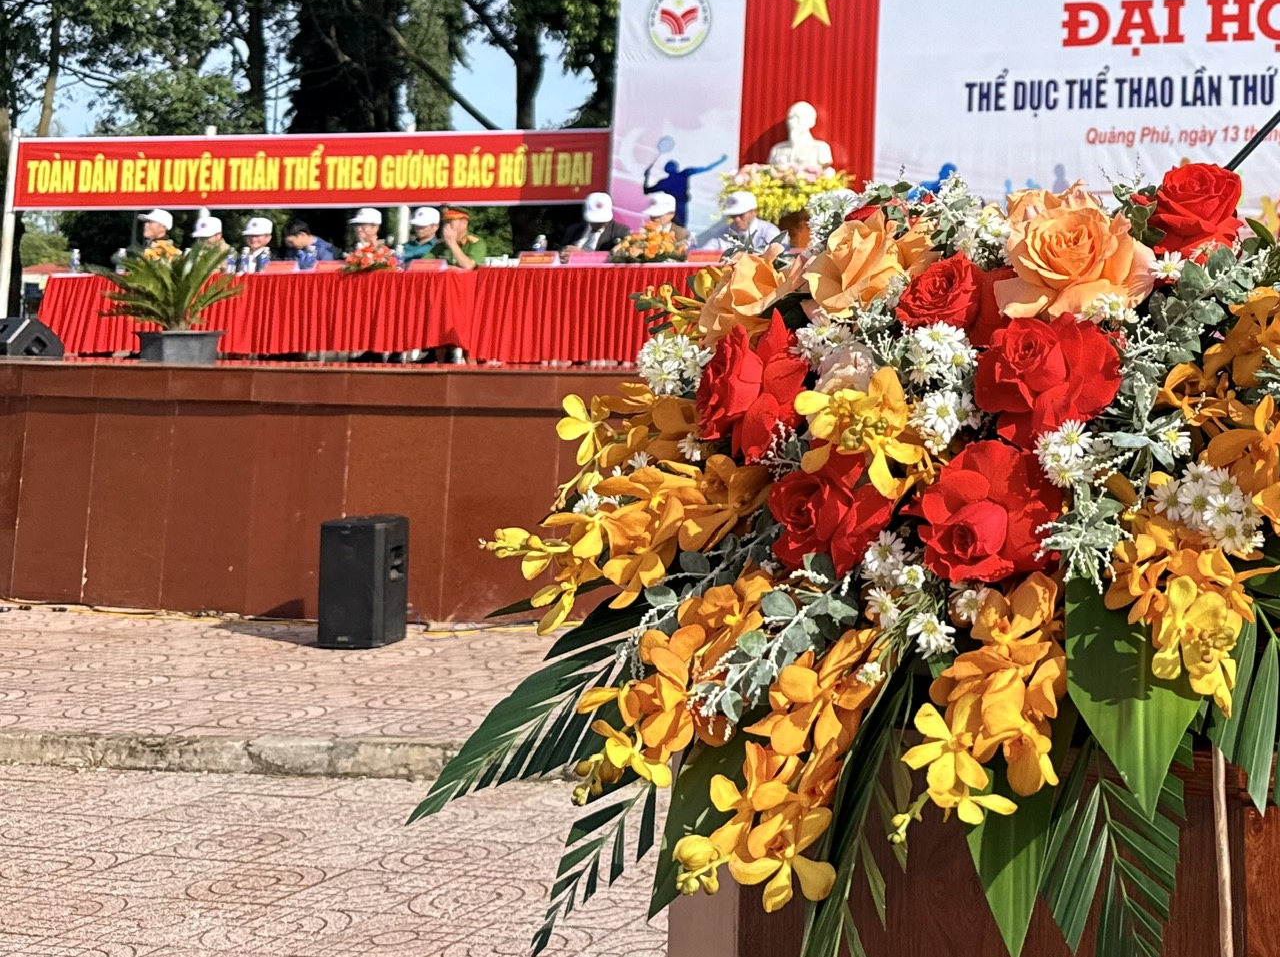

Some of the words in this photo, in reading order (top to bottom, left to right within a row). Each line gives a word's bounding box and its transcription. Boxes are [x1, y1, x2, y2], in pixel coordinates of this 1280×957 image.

[964, 68, 1009, 112] THỂ
[1013, 79, 1059, 118] DỤC
[1064, 65, 1110, 110] THỂ
[1114, 75, 1174, 108] THAO
[1180, 65, 1222, 107] LẦN
[1228, 66, 1279, 106] THỨ
[1086, 127, 1135, 148] Quảng
[1178, 124, 1216, 146] ngày
[1222, 125, 1239, 142] 13
[27, 153, 76, 194] TOÀN
[78, 153, 119, 193] DÂN
[120, 152, 160, 193] RÈN
[163, 151, 226, 198] LUYỆN
[228, 151, 280, 191] THÂN
[283, 144, 325, 190] THỂ
[325, 155, 377, 190] THEO
[380, 149, 450, 190] GƯƠNG
[452, 146, 495, 188] BÁC
[531, 147, 555, 186] VĨ
[556, 151, 593, 192] ĐẠI
